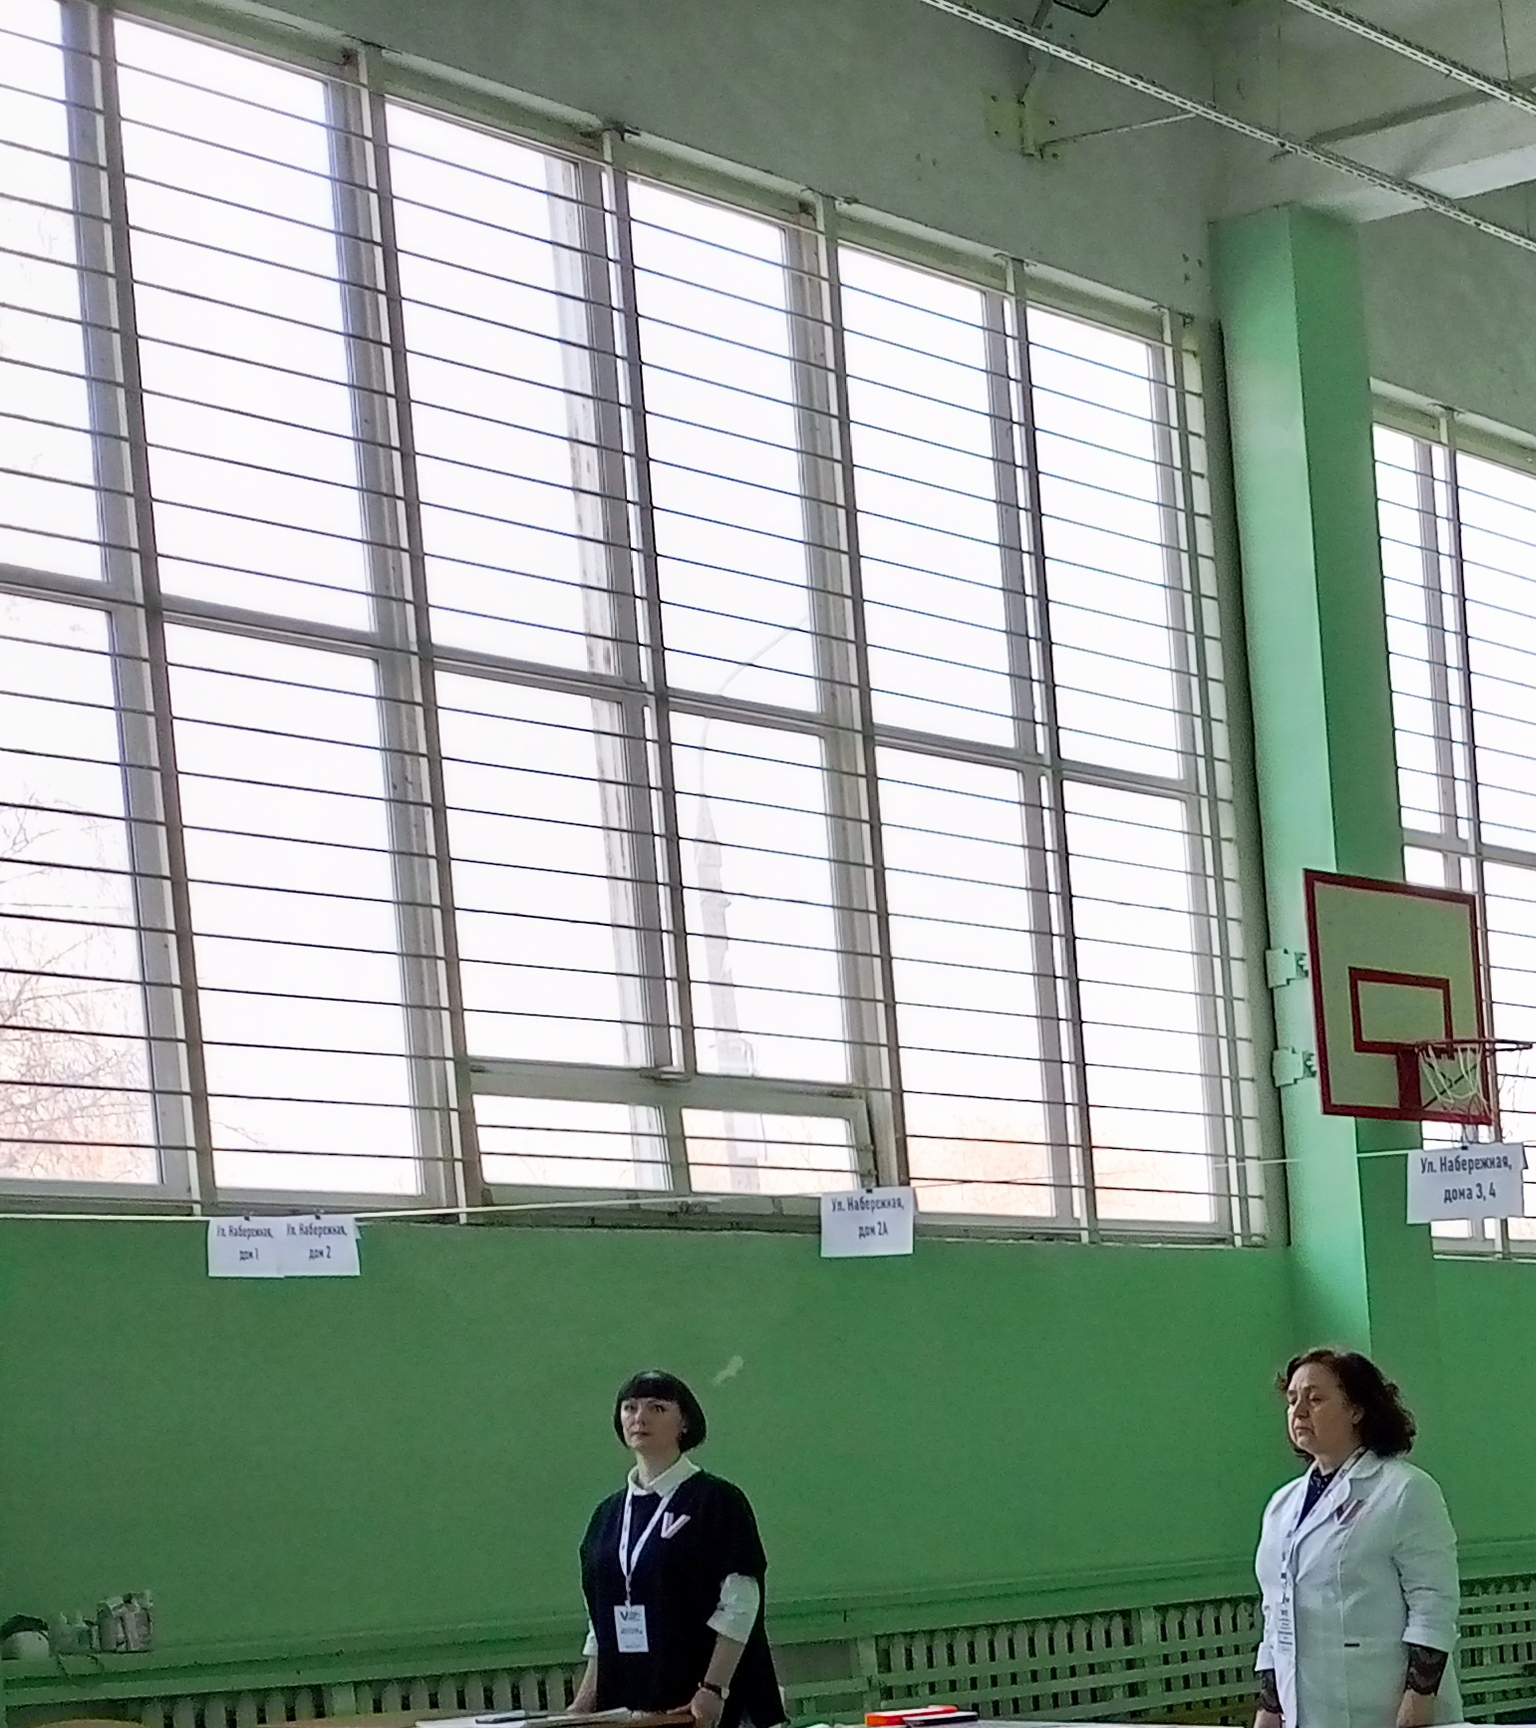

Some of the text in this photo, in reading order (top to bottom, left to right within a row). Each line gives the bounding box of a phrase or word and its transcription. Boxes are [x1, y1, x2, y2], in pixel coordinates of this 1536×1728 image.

[1420, 1155, 1513, 1175] Ул. Набережная,
[1444, 1182, 1497, 1204] дома 3, 4
[847, 1196, 905, 1213] Набережная,
[858, 1225, 876, 1239] дом
[325, 1245, 332, 1259] 2
